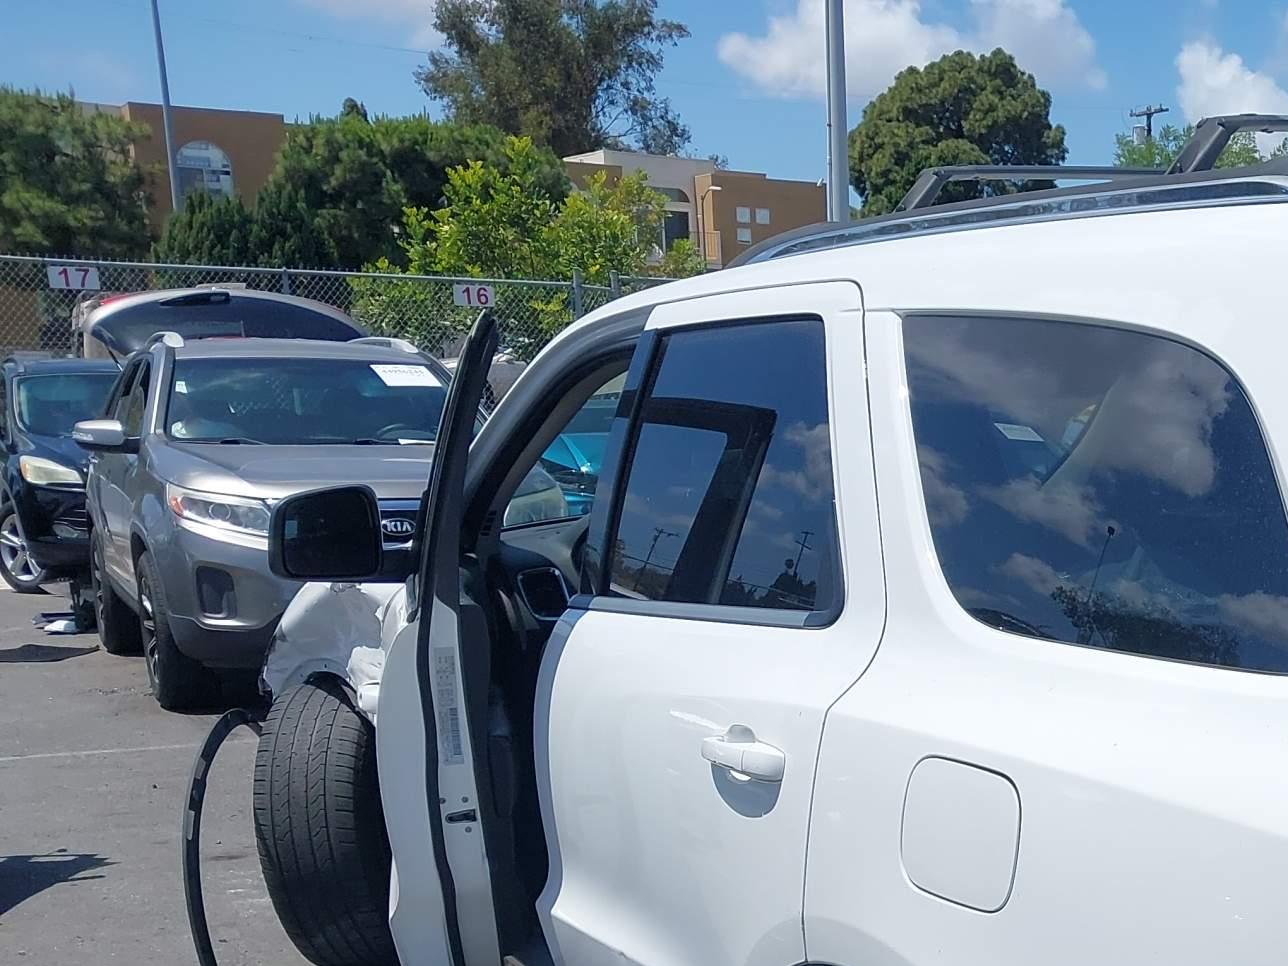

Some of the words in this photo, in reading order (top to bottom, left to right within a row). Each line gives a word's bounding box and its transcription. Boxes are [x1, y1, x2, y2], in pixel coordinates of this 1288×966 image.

[58, 267, 90, 288] 17
[462, 286, 489, 305] 16
[386, 521, 412, 532] KIA
